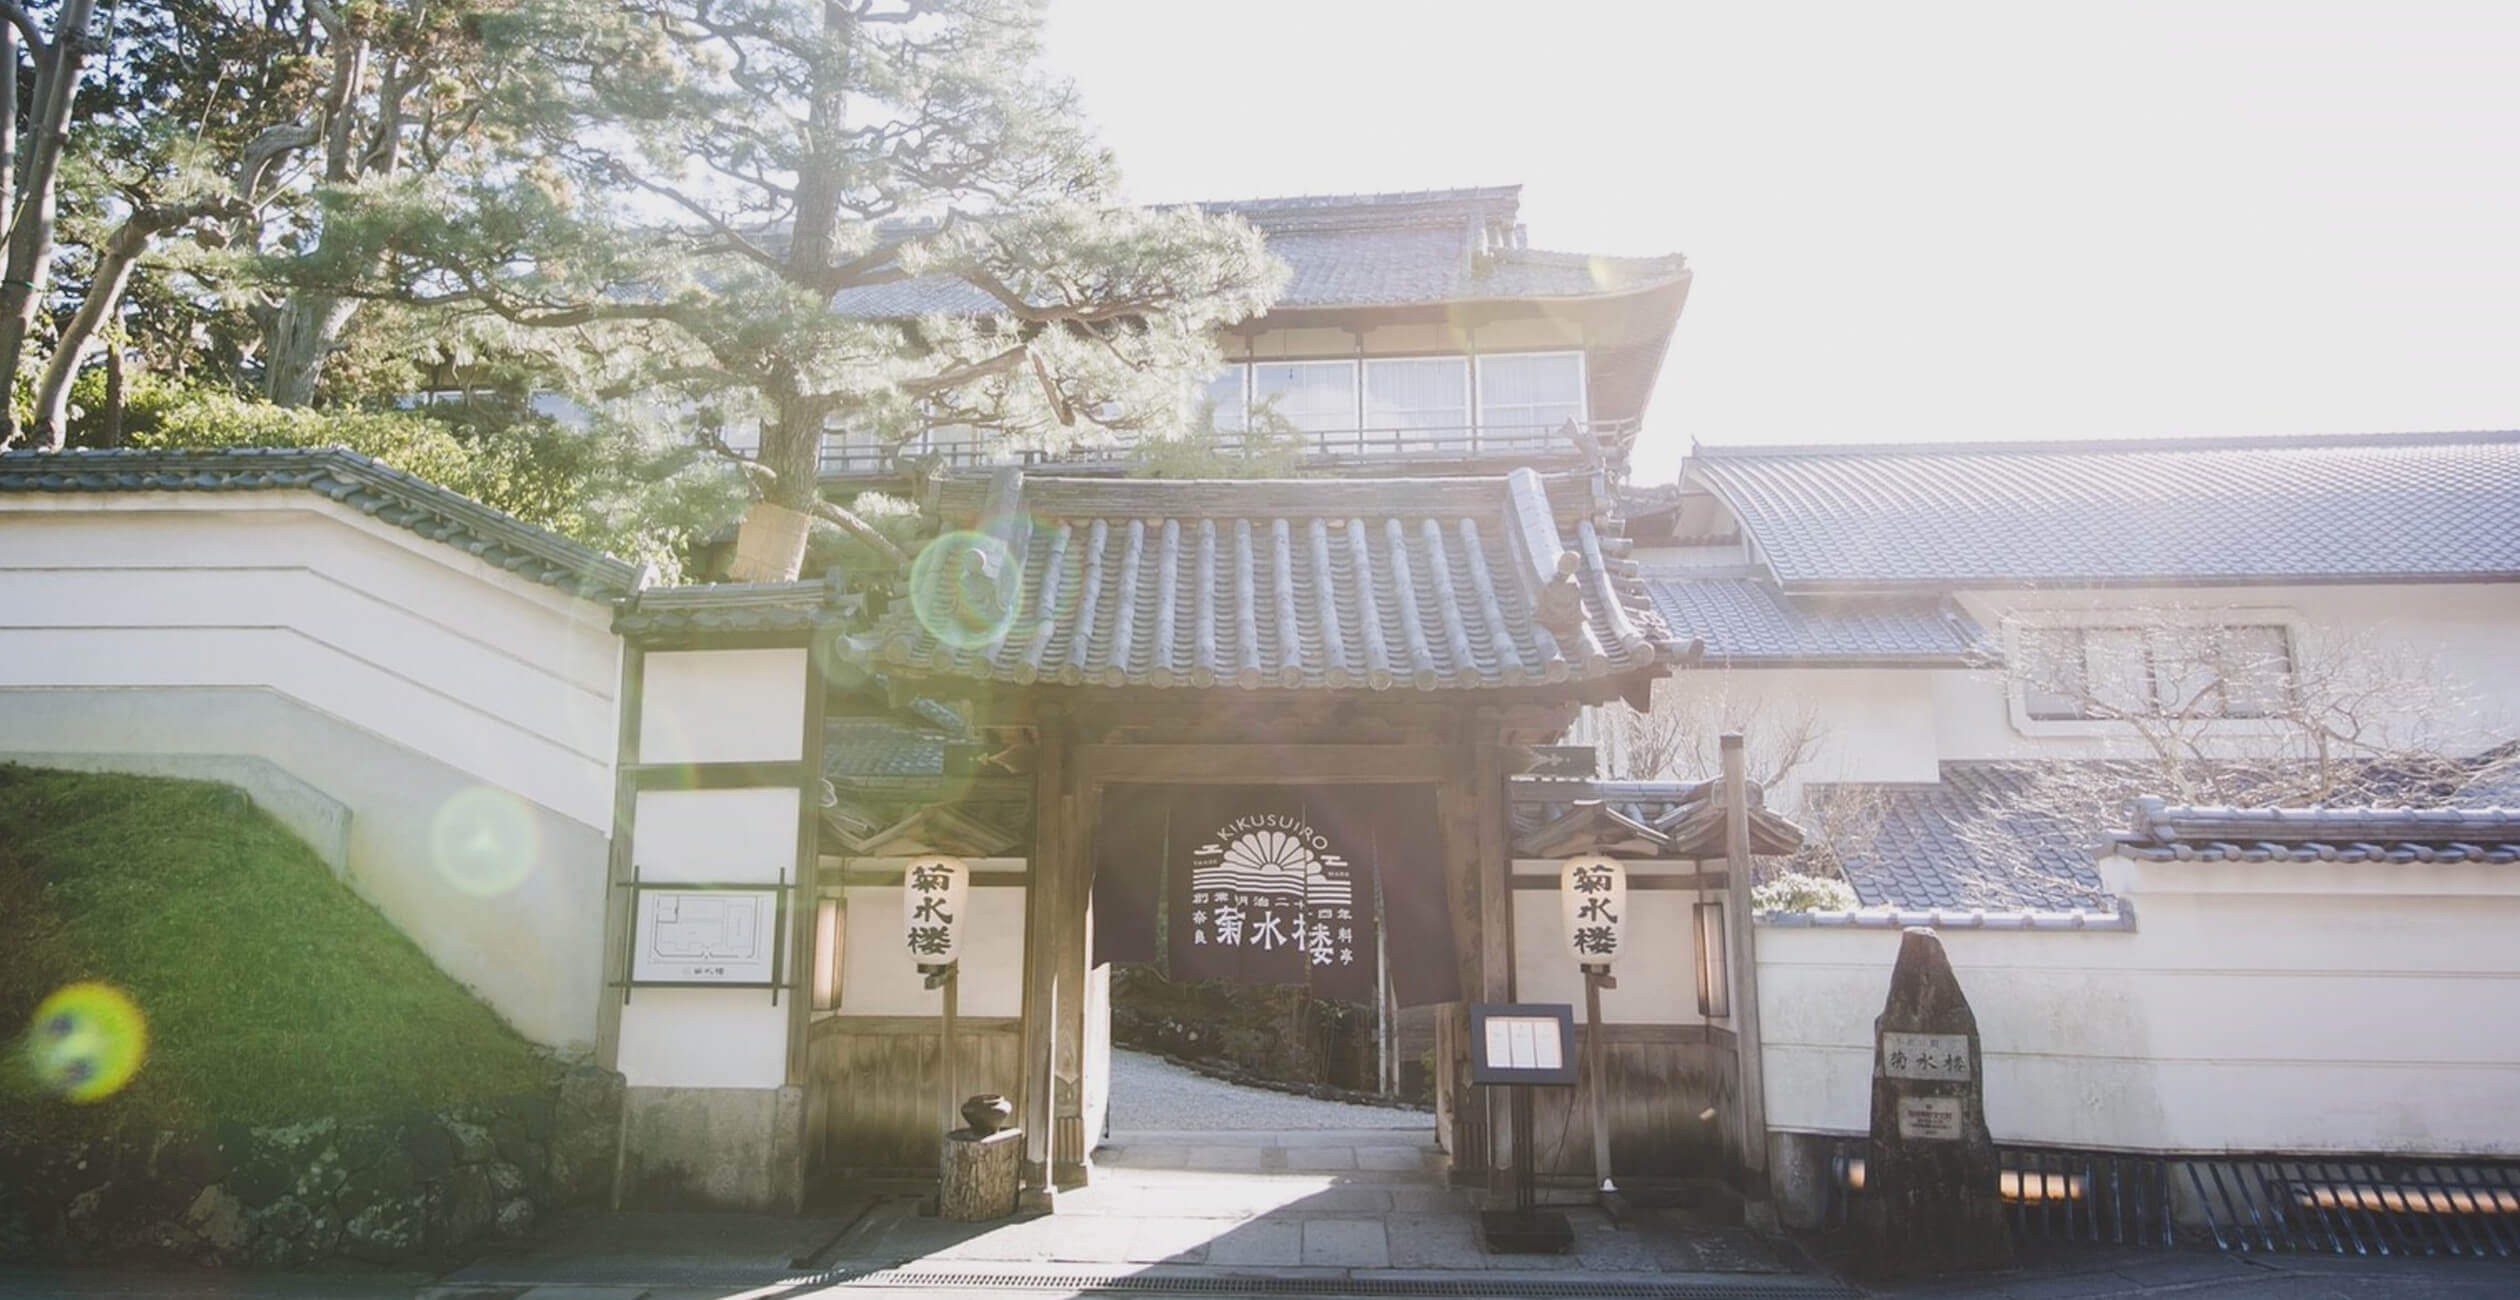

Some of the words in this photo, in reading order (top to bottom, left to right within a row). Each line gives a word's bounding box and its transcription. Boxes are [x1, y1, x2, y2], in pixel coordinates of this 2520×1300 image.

[1217, 814, 1329, 850] KIKUSUIRO
[908, 864, 954, 956] 菊水楼
[1214, 905, 1335, 966] 菊水楼
[1573, 864, 1618, 955] 菊水楼
